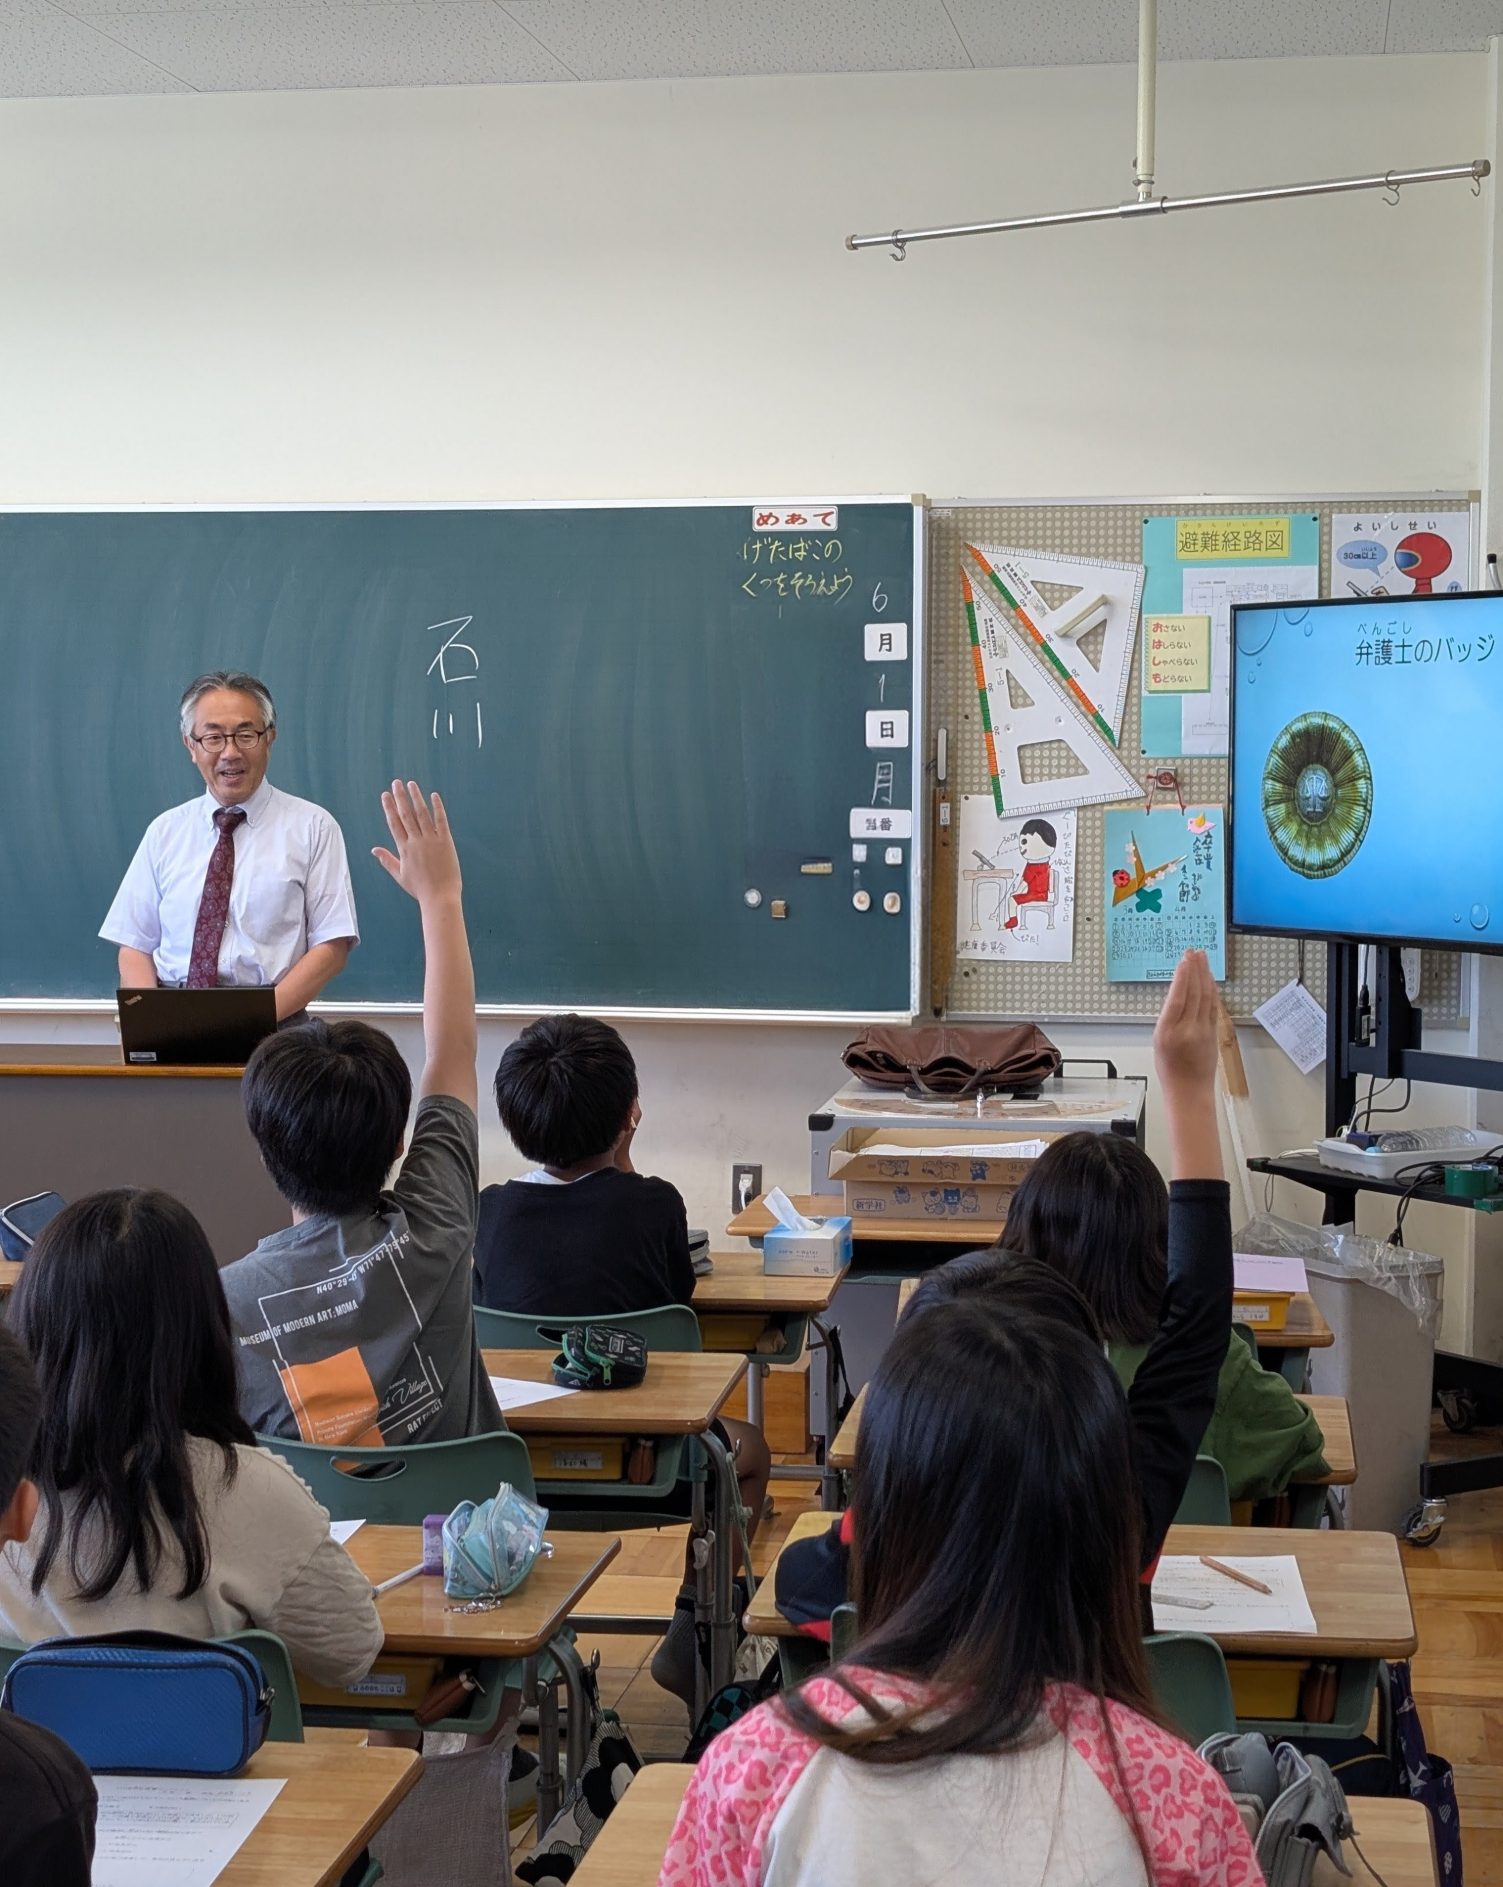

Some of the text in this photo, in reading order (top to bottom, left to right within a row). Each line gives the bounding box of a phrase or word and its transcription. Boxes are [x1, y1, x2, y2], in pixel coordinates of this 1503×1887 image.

[755, 511, 835, 527] めあて
[1353, 520, 1437, 532] よいしせい
[742, 537, 843, 563] げたばこの
[1178, 529, 1284, 553] 避難経路図
[741, 567, 853, 605] くつをそろえよう
[872, 581, 889, 613] 6
[1152, 622, 1186, 632] おさない
[1357, 620, 1413, 636] べんごし
[878, 633, 893, 653] 月
[1152, 639, 1192, 649] はしらない
[1354, 633, 1495, 666] 弁護士のバッジ
[1152, 656, 1198, 667] しゃべらない
[877, 673, 886, 703] 1
[1152, 673, 1193, 683] もどらない
[880, 721, 895, 740] 日
[871, 761, 893, 805] 月
[239, 1331, 272, 1347] MUSEUM
[272, 1324, 282, 1337] OF
[283, 1314, 316, 1333] MODERN
[392, 1379, 428, 1405] Village
